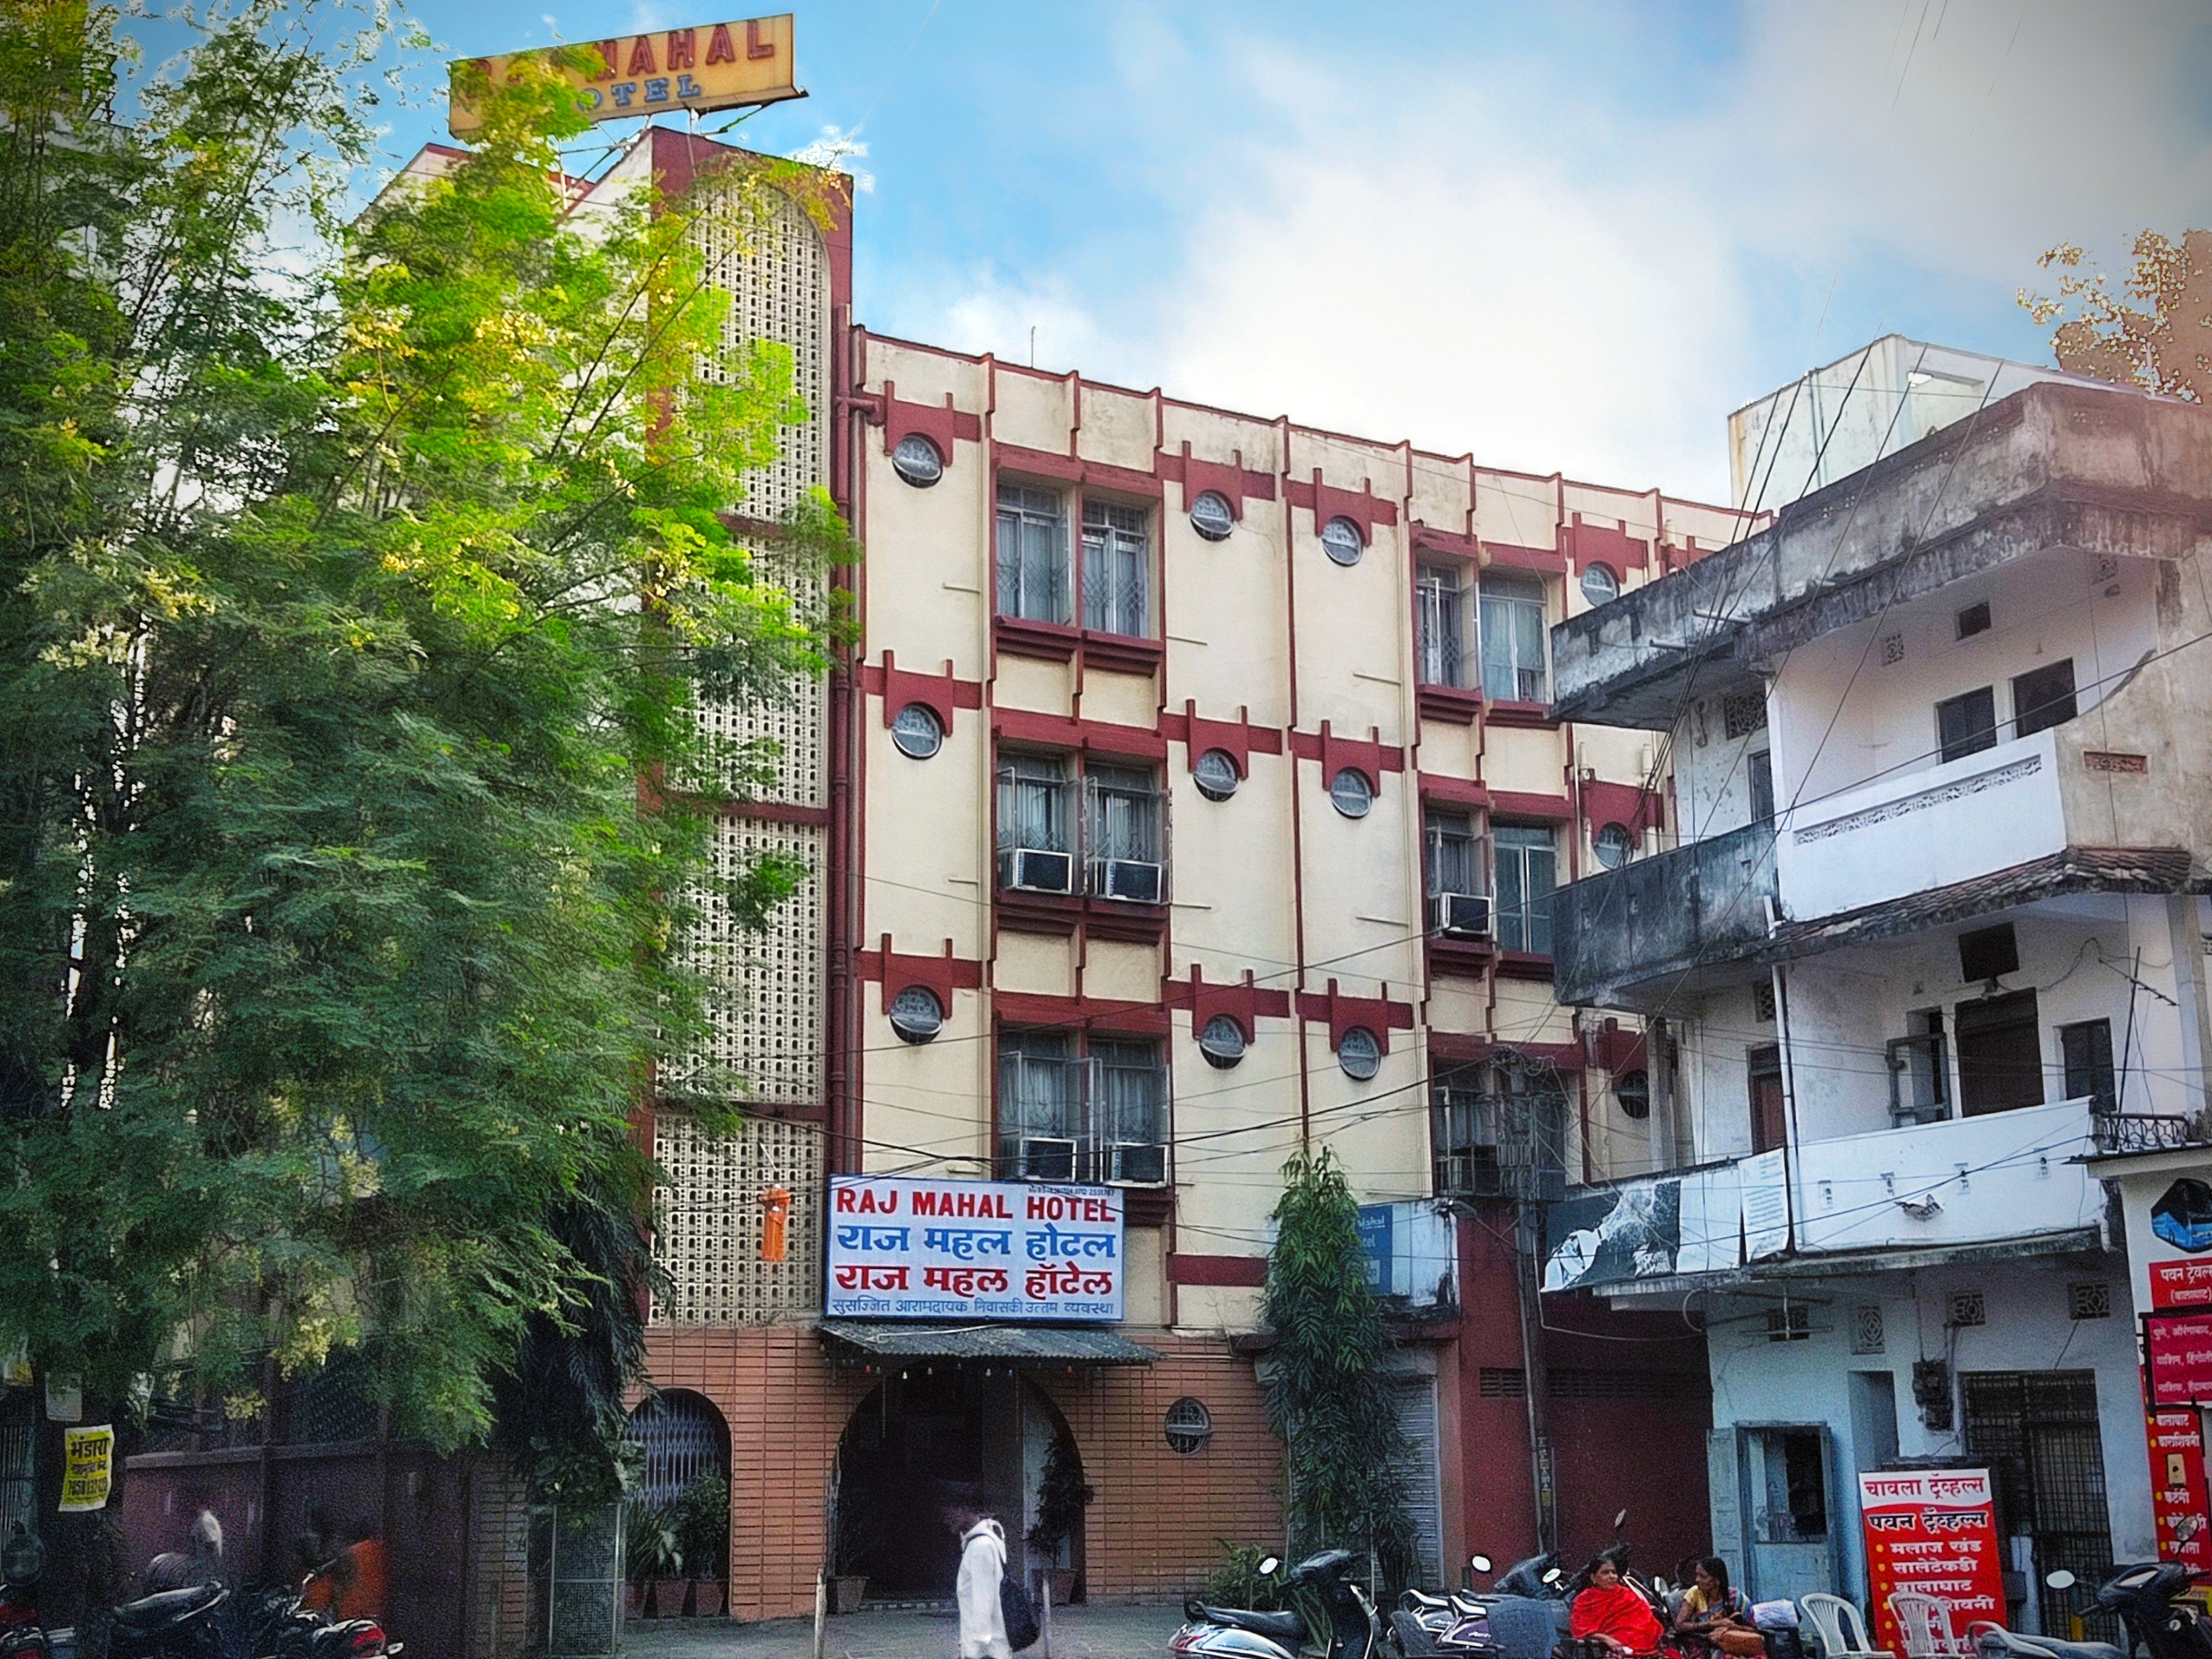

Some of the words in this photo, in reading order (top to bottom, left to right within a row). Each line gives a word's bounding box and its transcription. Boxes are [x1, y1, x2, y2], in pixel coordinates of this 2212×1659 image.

[577, 75, 701, 111] OTEL
[836, 1188, 898, 1214] RAJ
[912, 1192, 1013, 1219] MAHAL
[1027, 1196, 1116, 1222] HOTEL
[837, 1225, 910, 1251] राज
[924, 1228, 1012, 1260] महल
[1026, 1222, 1116, 1261] होटल
[834, 1265, 910, 1291] राज
[924, 1266, 1008, 1298] महल
[1025, 1261, 1113, 1300] हॉटेल
[2160, 1267, 2184, 1282] पवन
[832, 1295, 890, 1315] सुसज्जित
[895, 1300, 968, 1314] आरामदायक
[1063, 1302, 1114, 1314] व्यवस्था
[71, 1436, 110, 1458] भंडारा
[1864, 1480, 1922, 1496] चावला
[1869, 1513, 1916, 1531] पवन
[1890, 1541, 1944, 1554] मलाज
